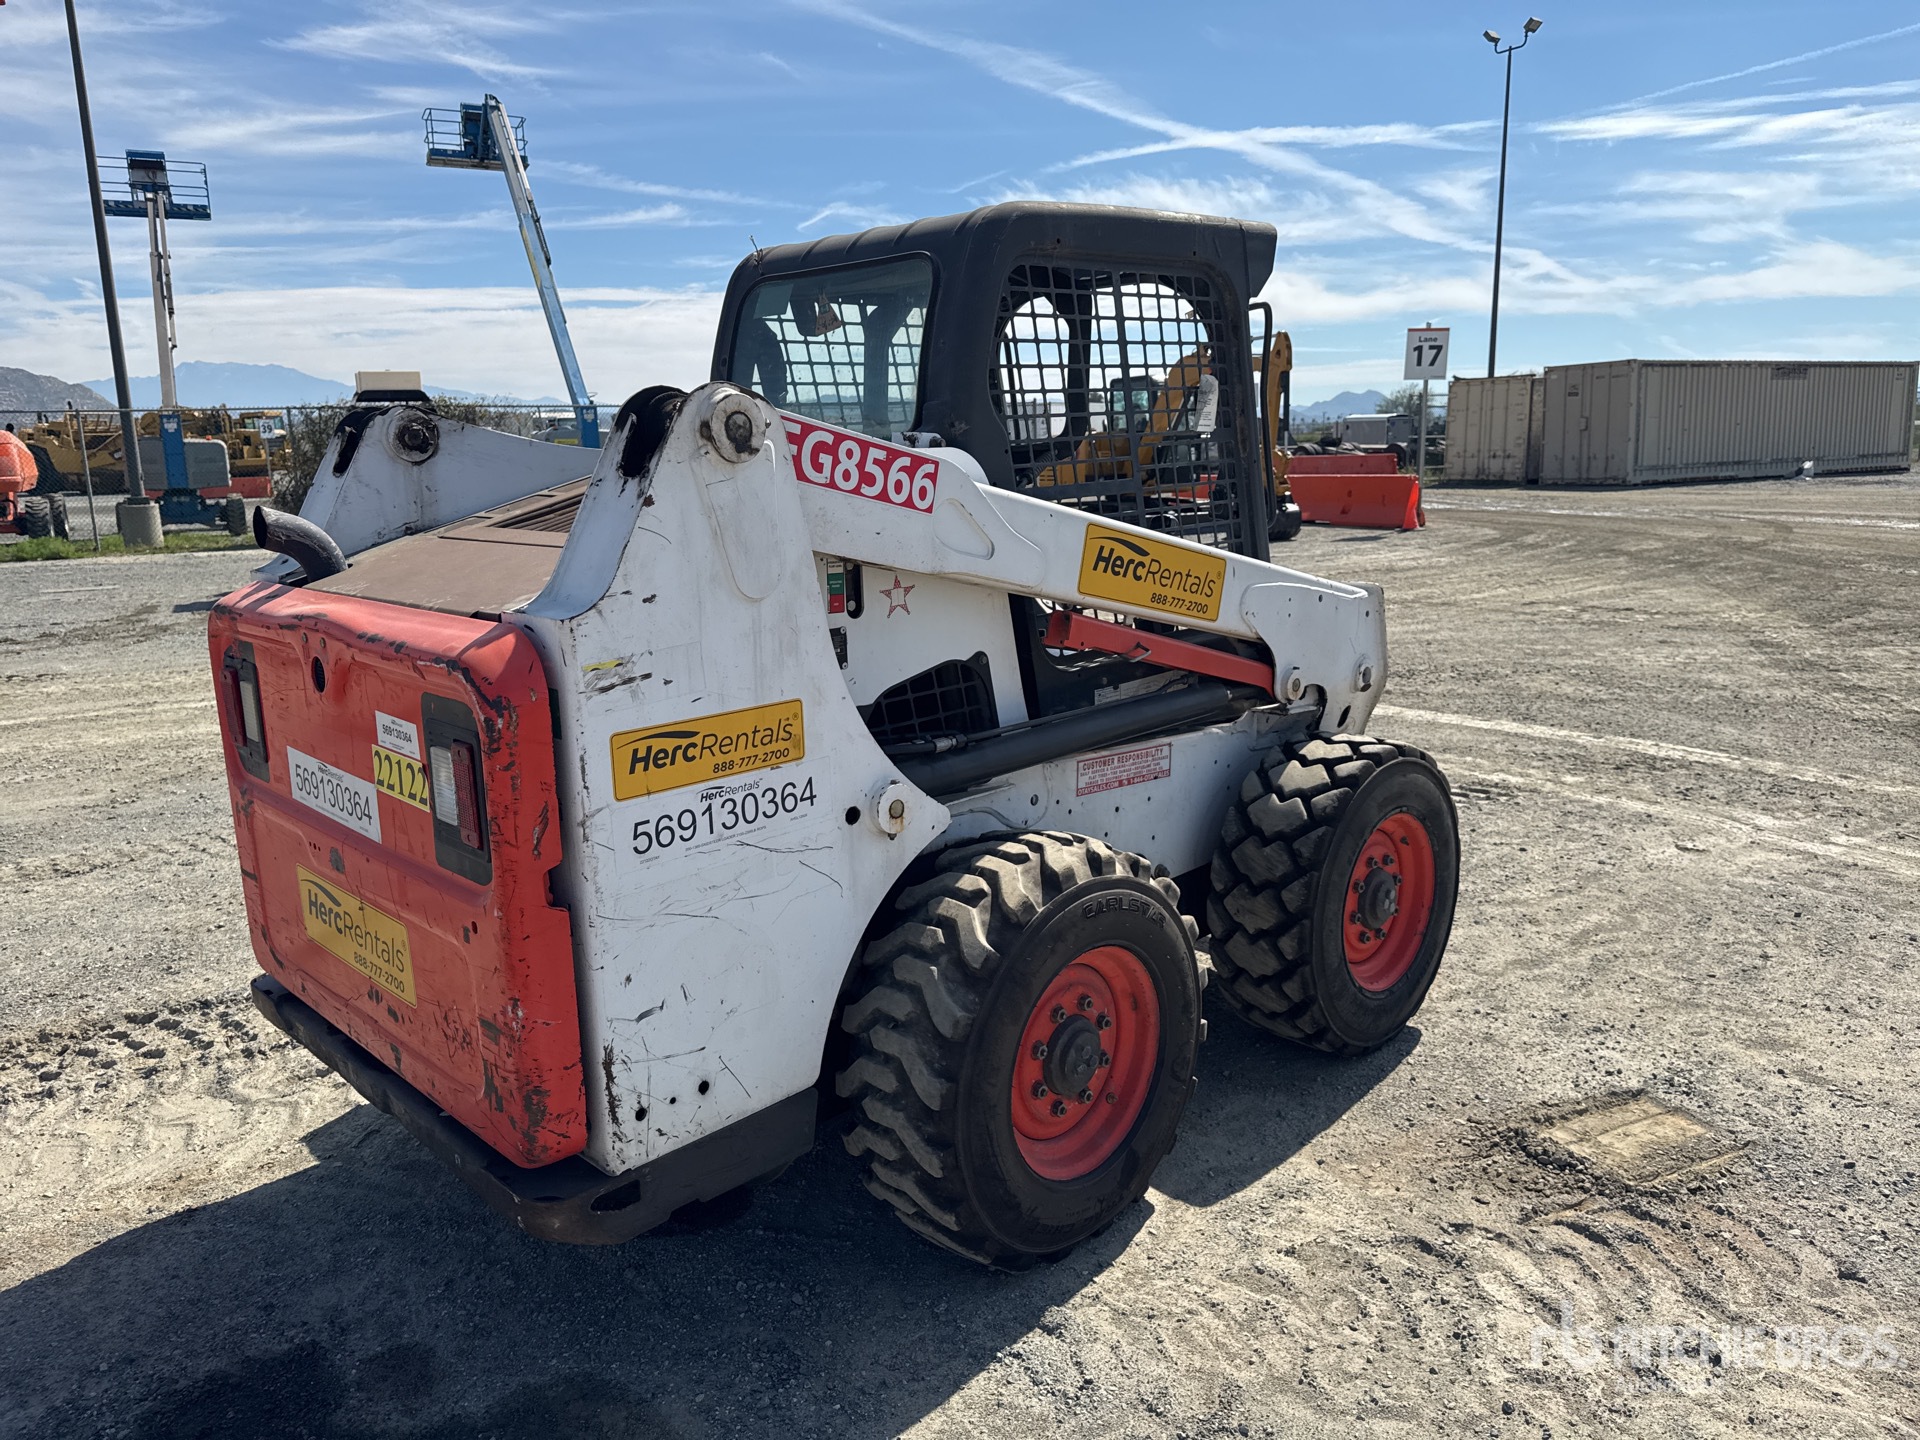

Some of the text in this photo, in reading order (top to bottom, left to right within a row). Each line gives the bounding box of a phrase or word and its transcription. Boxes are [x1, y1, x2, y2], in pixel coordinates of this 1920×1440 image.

[1413, 344, 1443, 367] 17
[261, 424, 272, 433] 39
[1150, 592, 1209, 615] 888-777-2700
[382, 724, 413, 743] 569130364
[713, 747, 790, 774] 888-777-2700
[1082, 748, 1163, 772] CUSTOMER RESPONSIBILITY
[373, 749, 428, 806] 22122
[1077, 781, 1119, 795] OTAYSALES.COM
[295, 763, 373, 826] 569130364
[632, 776, 817, 856] 569130364
[1083, 896, 1166, 928] CARLSTAR
[353, 951, 405, 994] 888-777-2700
